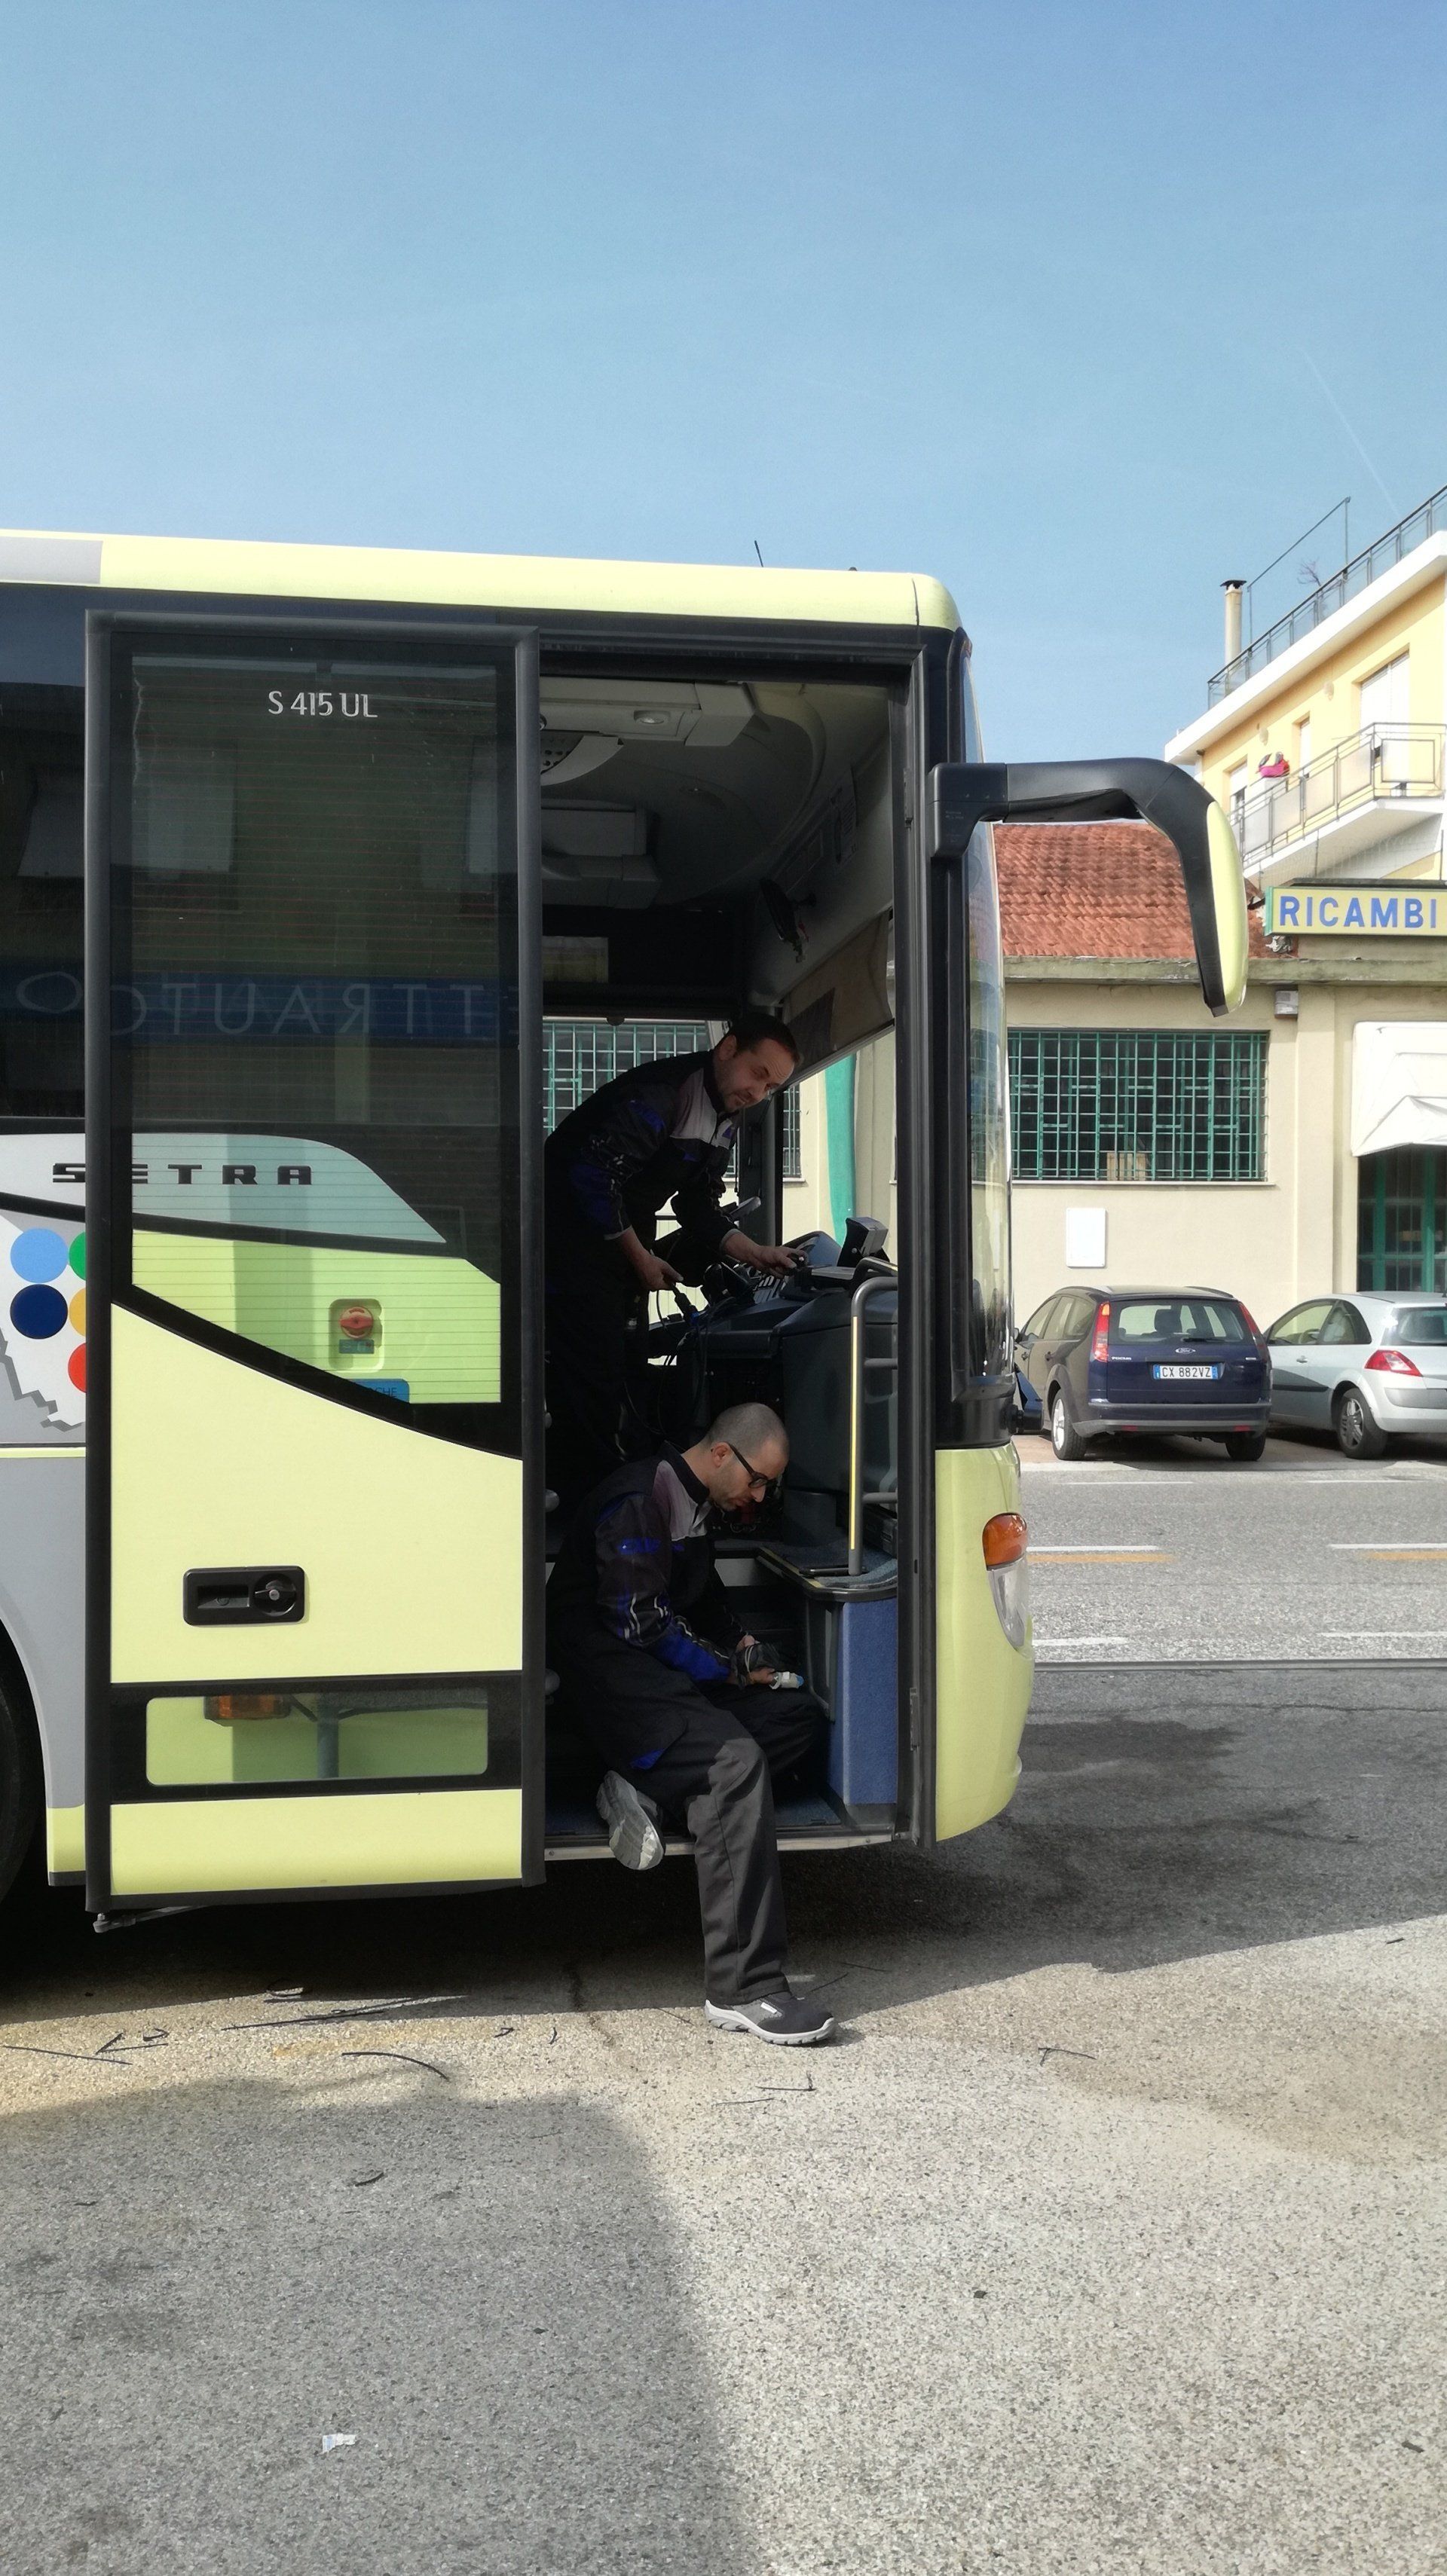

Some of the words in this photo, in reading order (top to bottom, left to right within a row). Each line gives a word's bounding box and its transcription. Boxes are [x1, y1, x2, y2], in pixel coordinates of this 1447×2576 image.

[268, 690, 283, 715] S
[290, 692, 333, 717] 415
[339, 692, 378, 718] UL
[1279, 895, 1436, 929] RICAMBI
[1161, 1367, 1175, 1377] CX
[1178, 1367, 1212, 1378] 882VZ
